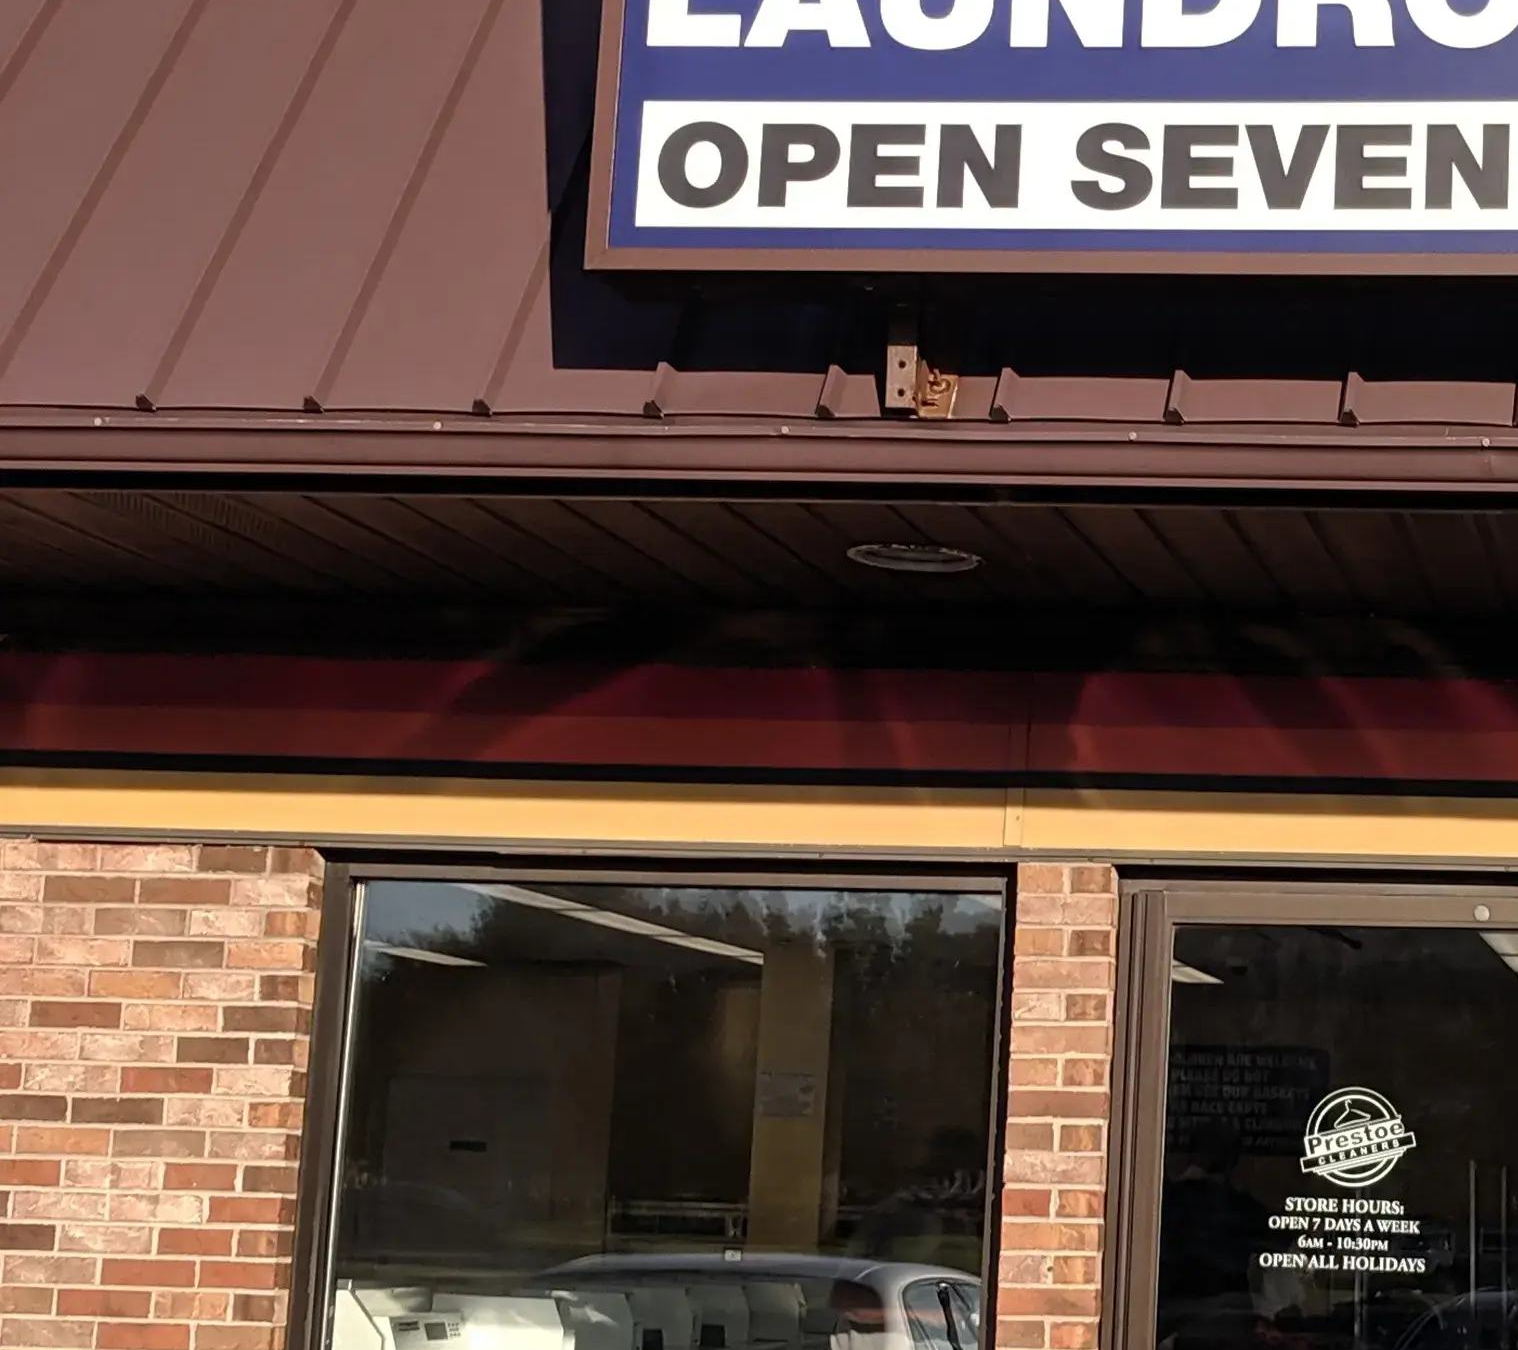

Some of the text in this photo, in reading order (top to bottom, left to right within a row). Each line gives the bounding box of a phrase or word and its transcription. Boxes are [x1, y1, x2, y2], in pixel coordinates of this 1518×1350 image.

[656, 120, 1023, 211] OPEN
[1070, 120, 1510, 211] SEVEN
[1307, 1122, 1404, 1155] Prestoe
[1318, 1138, 1400, 1165] CLEANERS
[1284, 1196, 1339, 1213] STORE
[1268, 1215, 1421, 1235] OPEN 7 DAYS A WEEK
[1297, 1234, 1324, 1250] 6AM
[1336, 1236, 1389, 1252] 10:30PM
[1258, 1252, 1427, 1273] OPEN ALL HOLIDAYS
